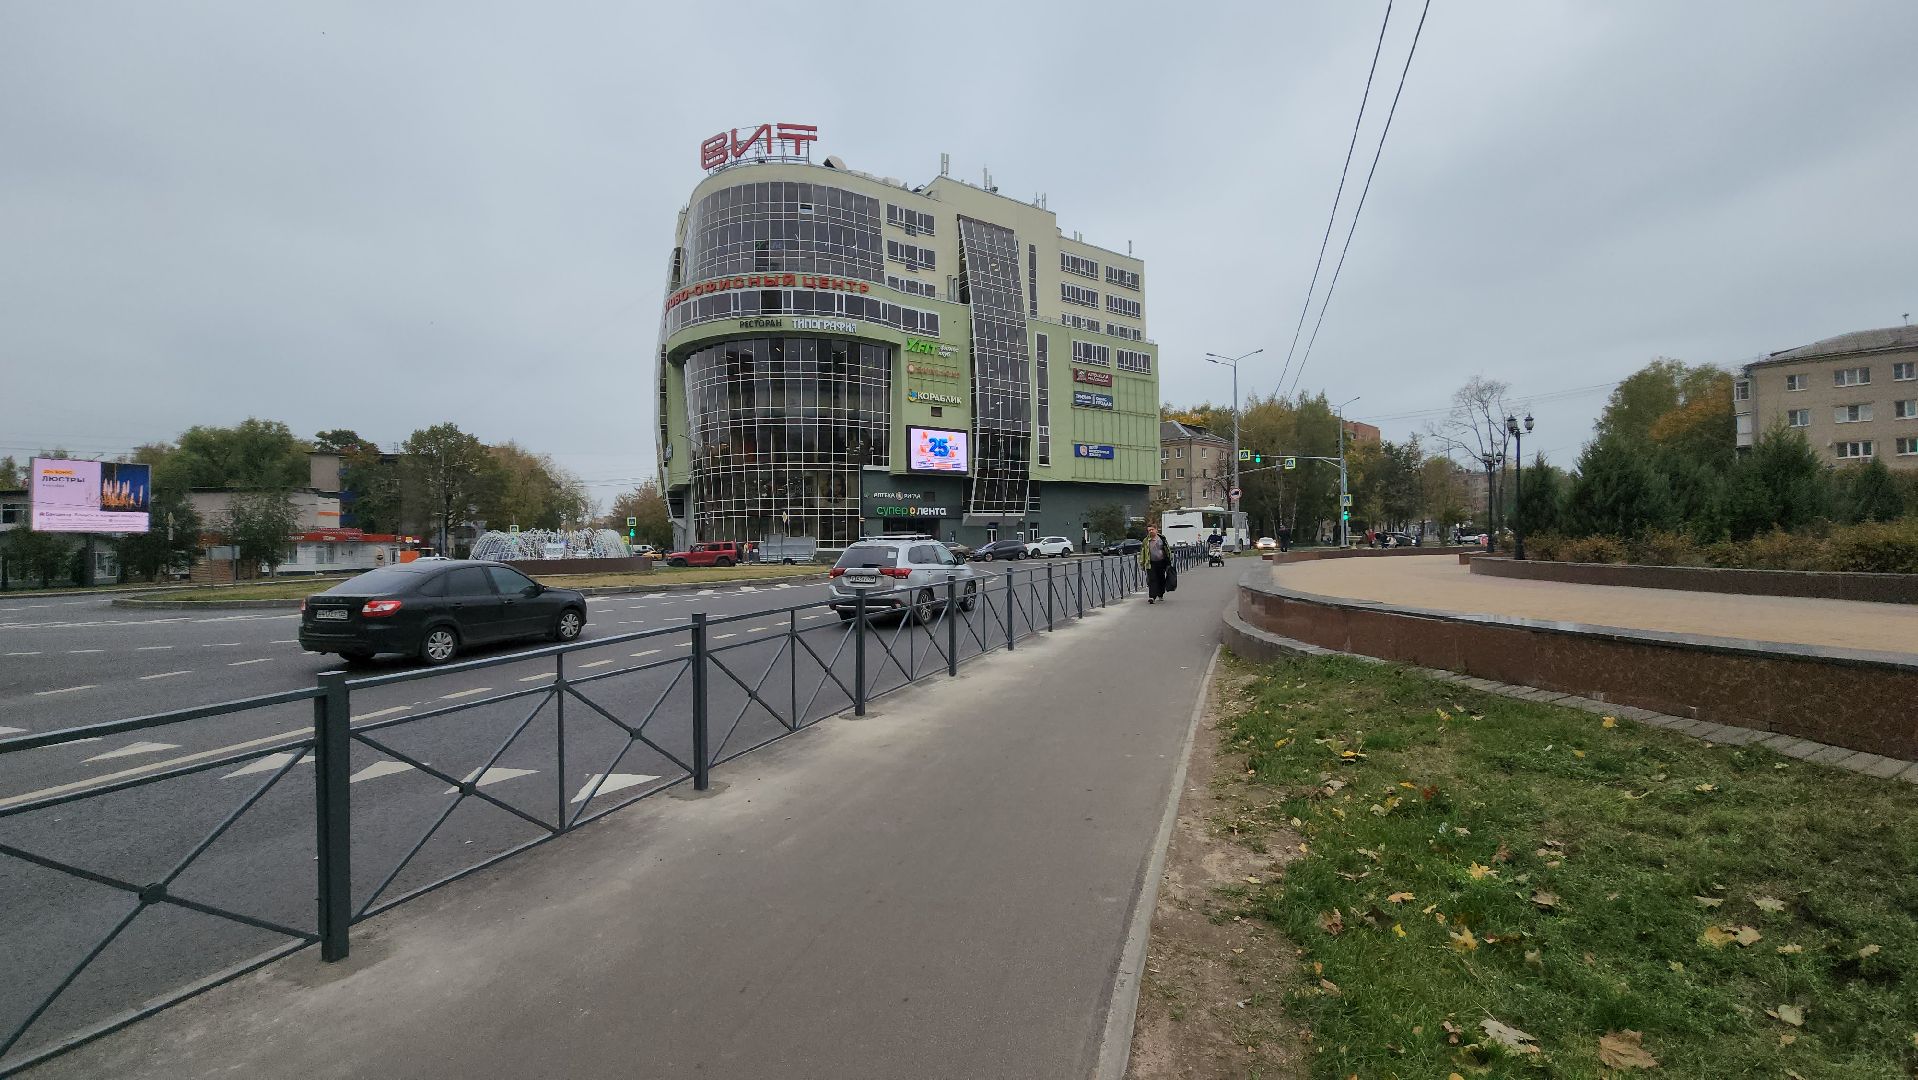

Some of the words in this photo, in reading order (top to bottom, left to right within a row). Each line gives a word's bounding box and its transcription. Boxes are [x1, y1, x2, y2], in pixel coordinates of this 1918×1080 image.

[701, 123, 817, 170] ВИТ
[802, 275, 870, 294] ЦЕНТР
[739, 319, 782, 329] РЕСТОРАН
[792, 318, 857, 333] ТИПОГРАФИЯ
[917, 391, 962, 404] КОРАБЛИК
[928, 437, 950, 458] 25
[42, 475, 86, 483] ЛЮСТРЫ
[876, 505, 908, 517] супер
[916, 506, 947, 516] лента
